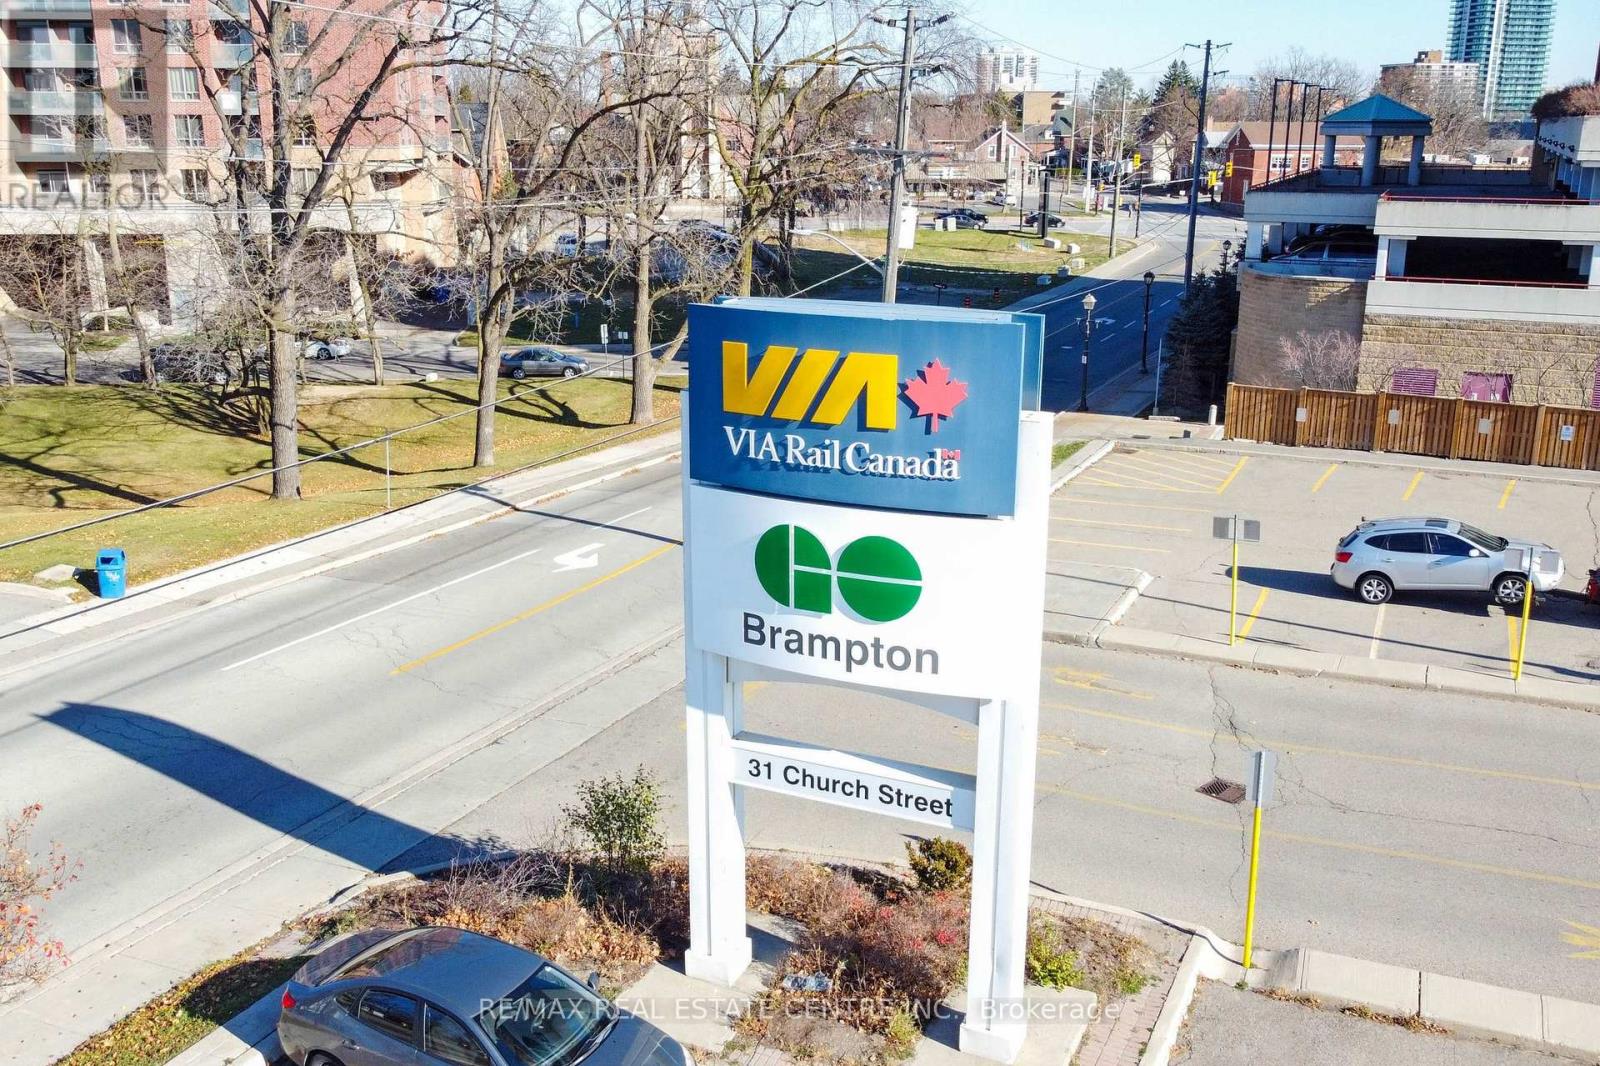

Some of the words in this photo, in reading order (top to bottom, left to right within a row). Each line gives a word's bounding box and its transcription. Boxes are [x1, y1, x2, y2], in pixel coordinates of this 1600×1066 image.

[722, 341, 898, 431] VIA
[723, 425, 780, 463] VIA
[786, 433, 841, 470] Rail
[845, 441, 961, 481] Canada
[754, 523, 923, 623] GO
[743, 611, 940, 675] Brampton
[748, 758, 772, 781] 31
[783, 765, 869, 800] Church
[878, 783, 954, 818] Street
